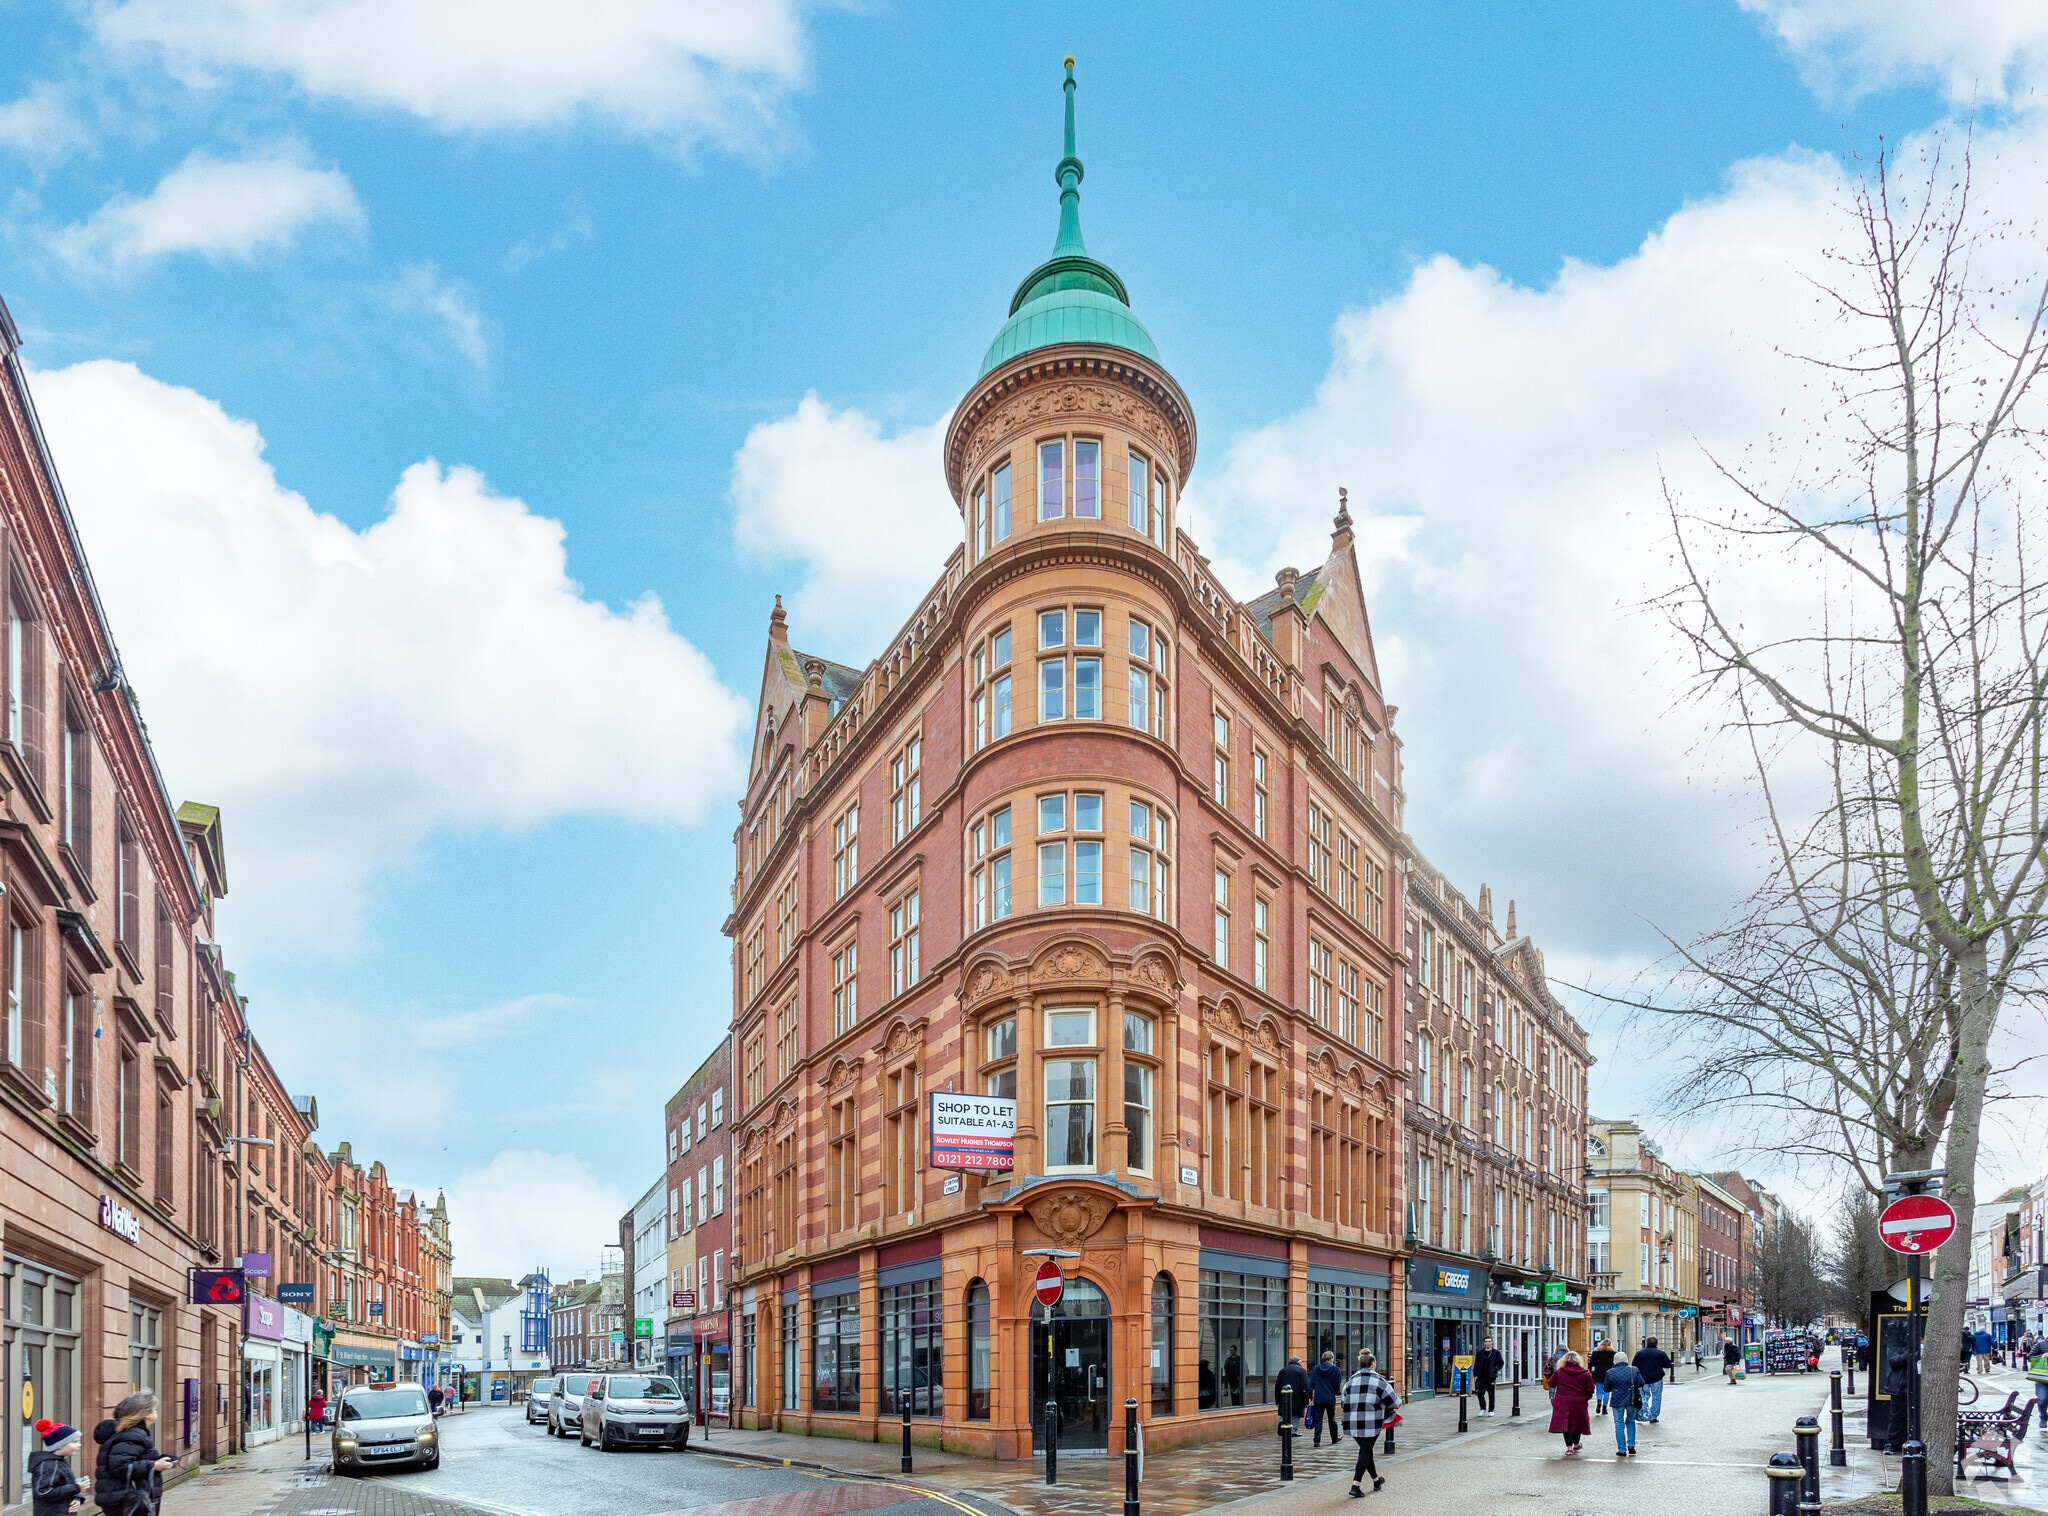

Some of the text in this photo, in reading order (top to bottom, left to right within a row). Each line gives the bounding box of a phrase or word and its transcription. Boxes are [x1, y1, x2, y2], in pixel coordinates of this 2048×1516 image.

[938, 1102, 1013, 1116] SHOP TO LET
[938, 1116, 1014, 1128] SUITABLE A1-A3
[938, 1154, 1014, 1166] 0121 212 7800
[111, 1199, 140, 1244] NatWest
[1444, 1272, 1470, 1290] GREGGS
[260, 1306, 274, 1330] Scope
